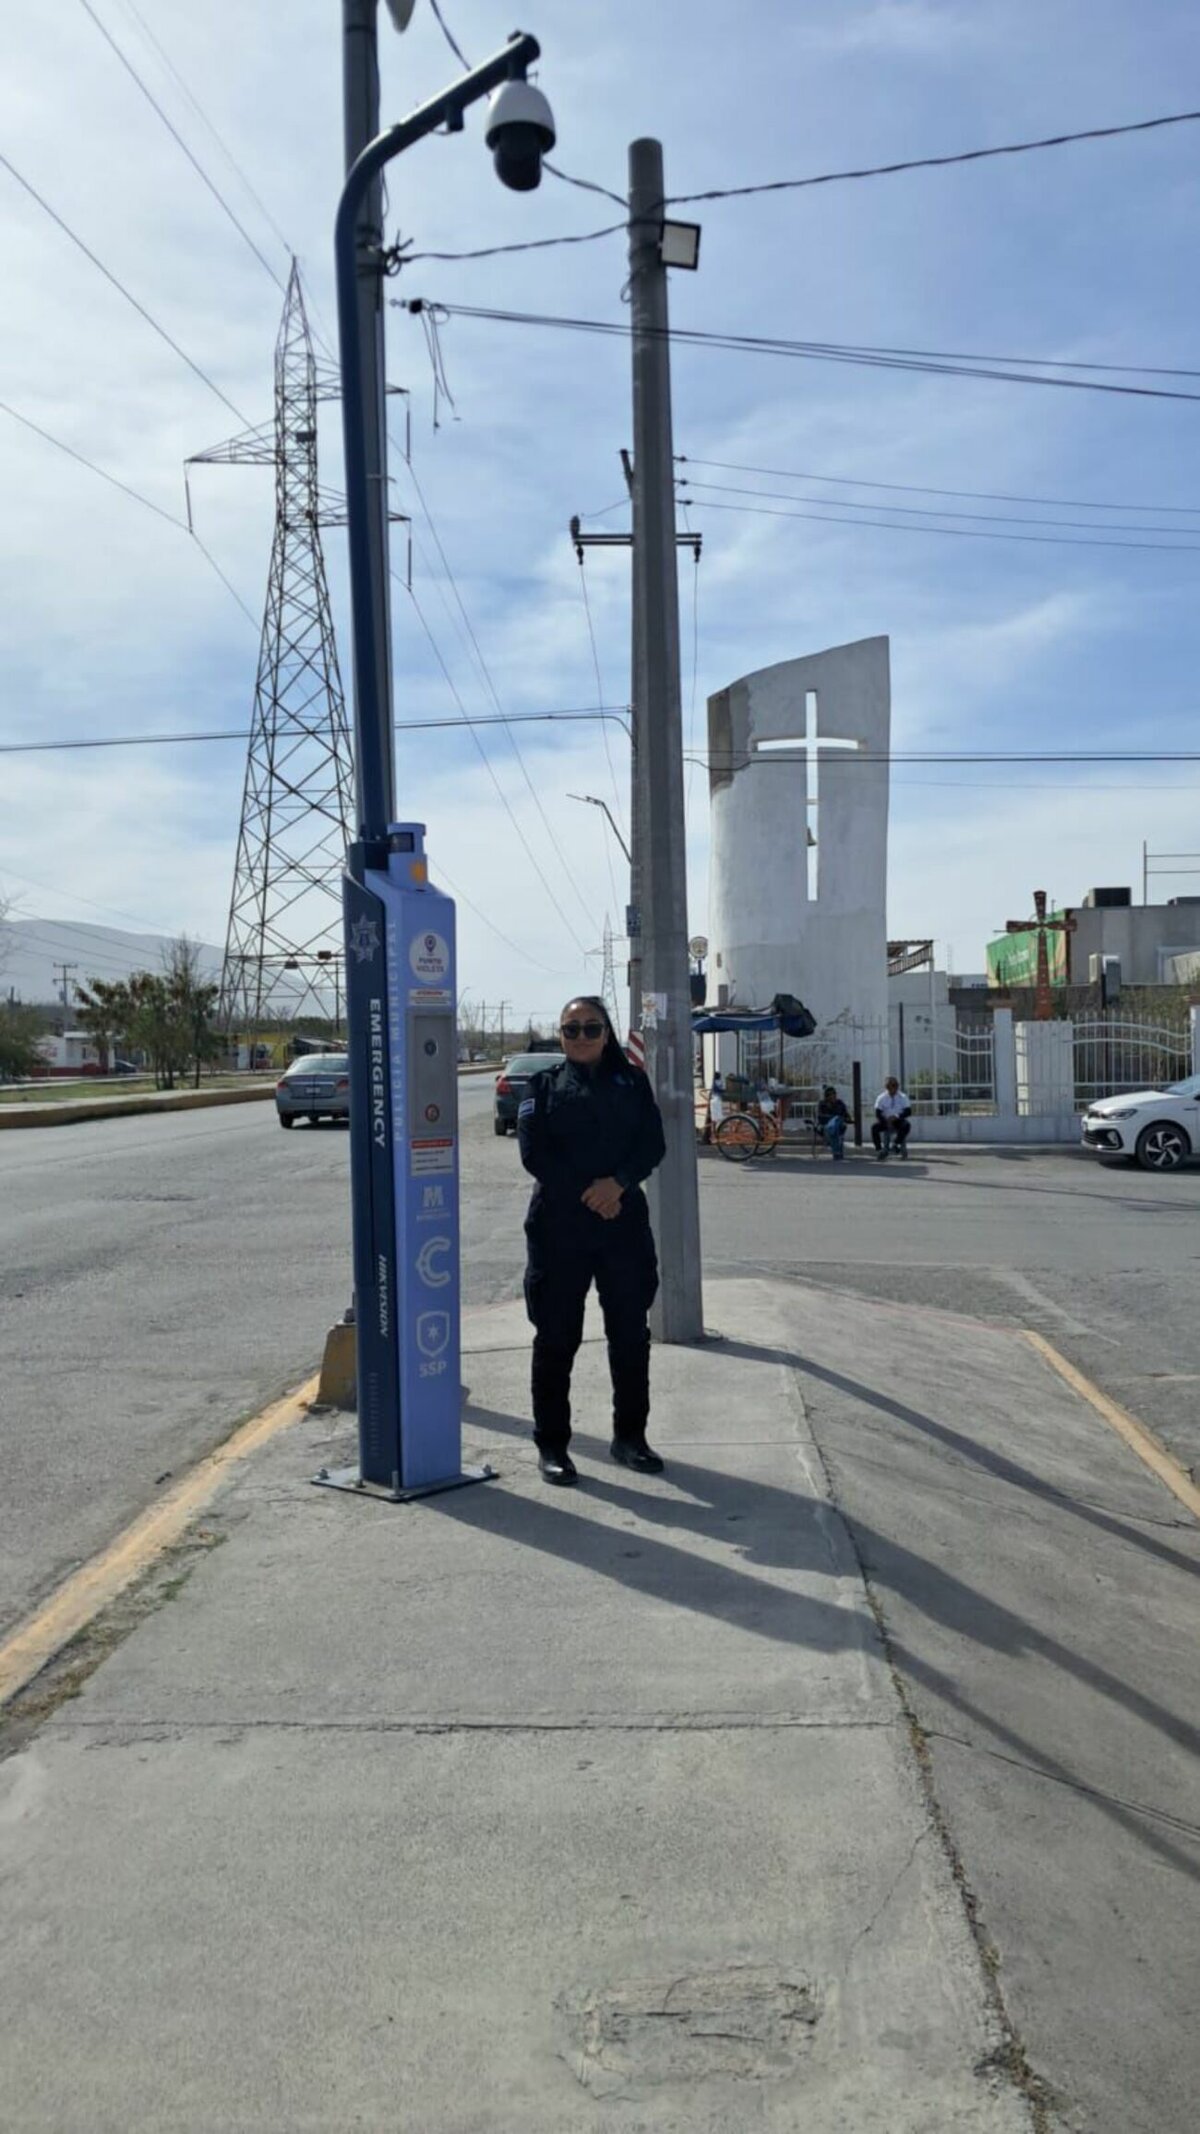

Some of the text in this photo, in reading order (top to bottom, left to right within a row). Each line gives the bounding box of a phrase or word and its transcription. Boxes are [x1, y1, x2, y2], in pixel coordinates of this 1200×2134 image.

[370, 999, 385, 1148] EMERGENCY
[379, 1254, 388, 1337] HIKVISION
[419, 1361, 447, 1378] SSP
